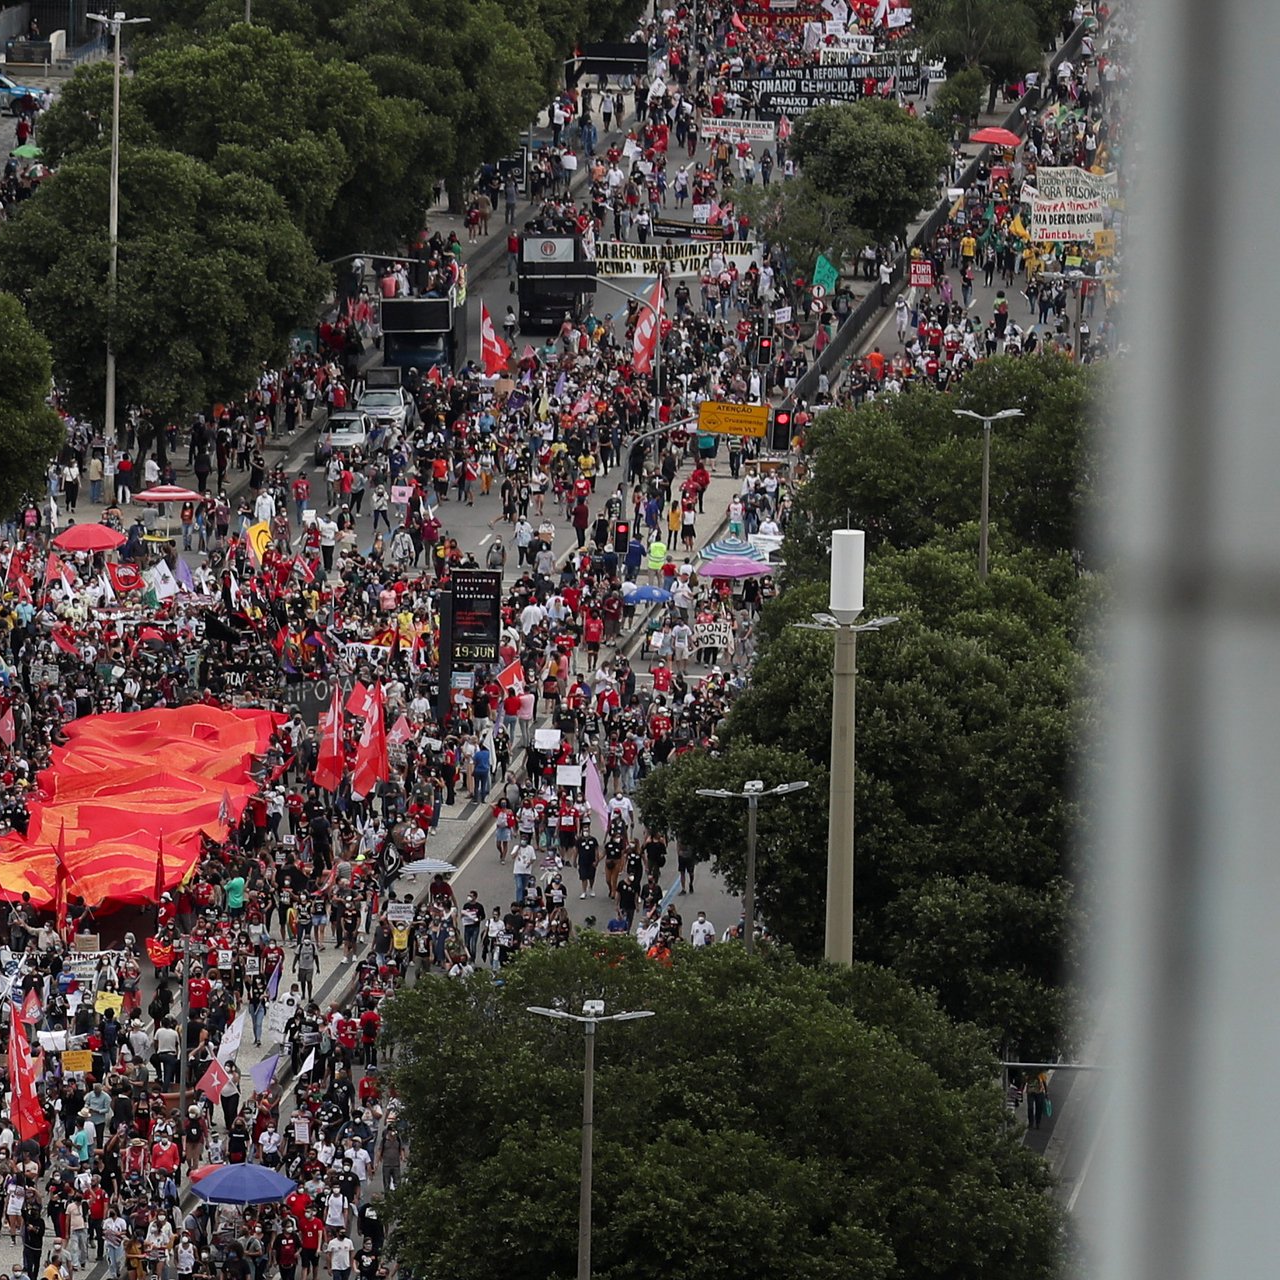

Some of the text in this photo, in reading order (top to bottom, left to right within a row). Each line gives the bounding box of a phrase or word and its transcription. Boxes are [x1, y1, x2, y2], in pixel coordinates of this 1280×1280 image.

[813, 67, 848, 79] REFORMA
[769, 96, 809, 107] ABAIXO
[1039, 186, 1062, 199] FORA
[611, 243, 658, 260] REFORMA
[597, 260, 637, 274] ACINA!
[681, 257, 710, 273] VIDA
[911, 263, 931, 274] FORA
[717, 404, 753, 414] ATENÇÃO
[724, 417, 764, 426] Cruzamento
[455, 646, 495, 659] 19-JUN
